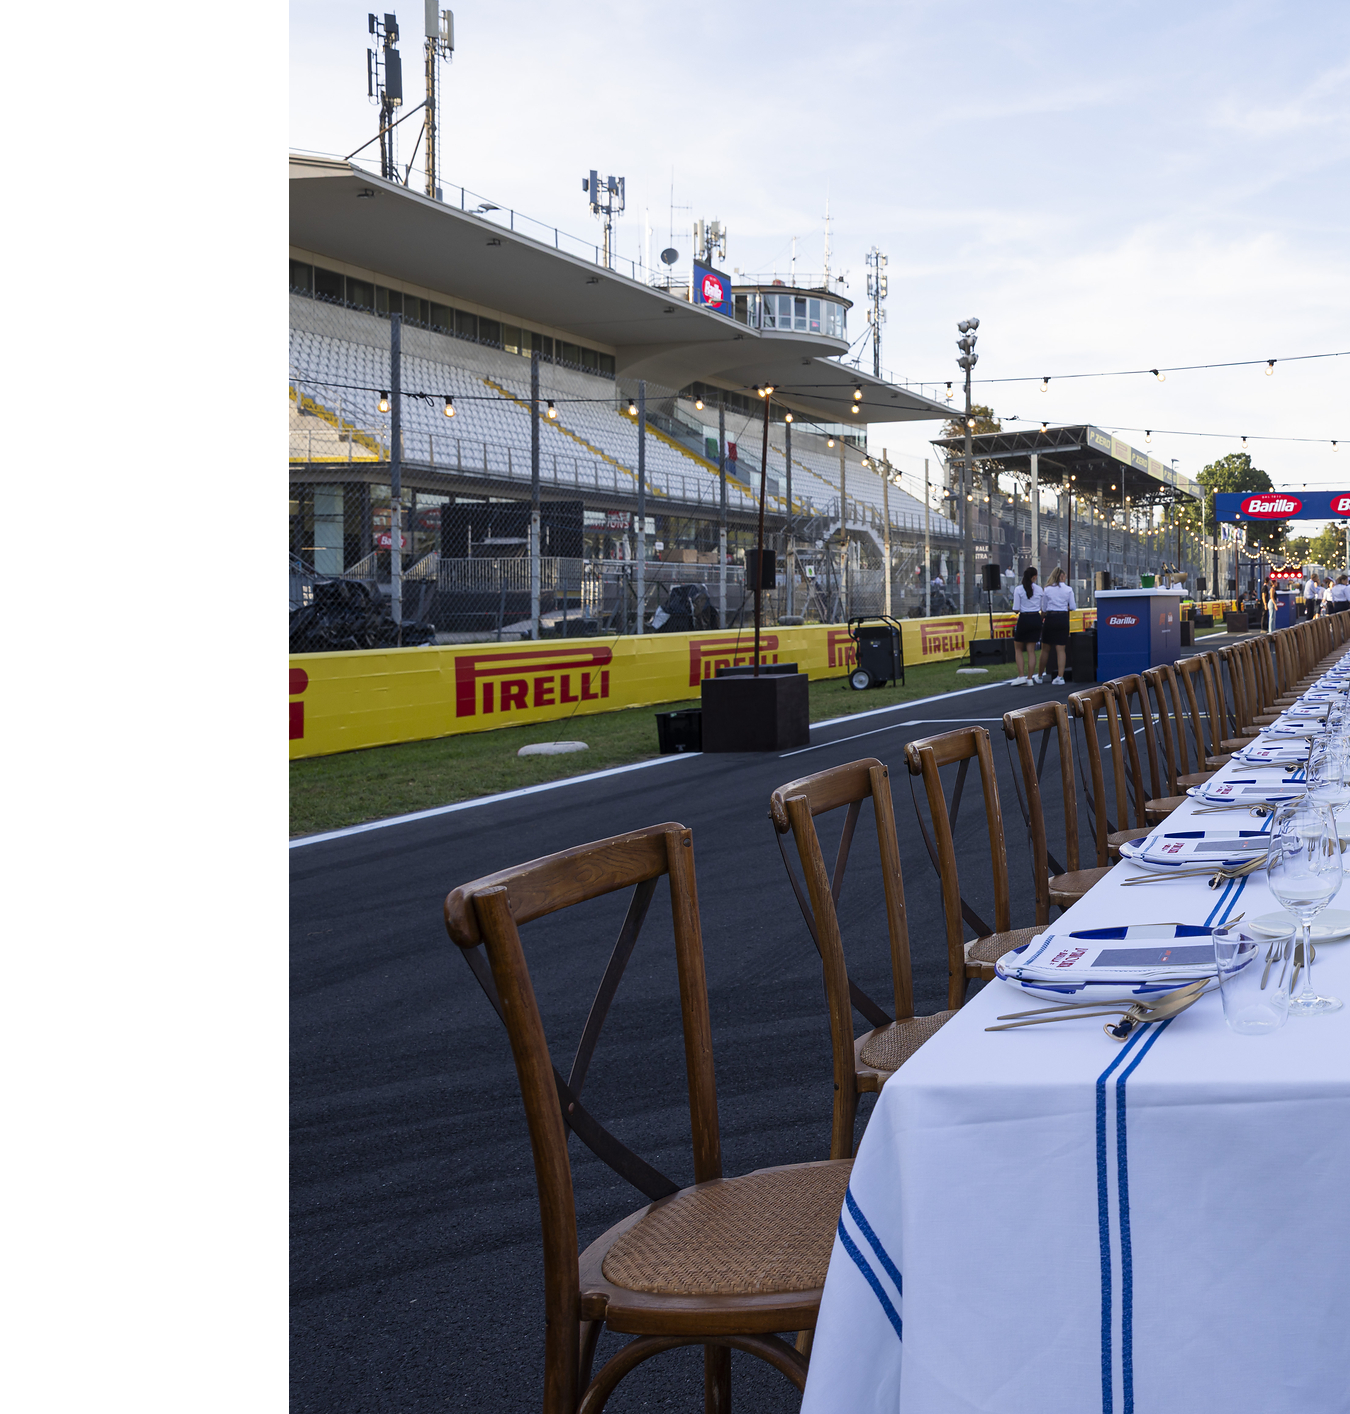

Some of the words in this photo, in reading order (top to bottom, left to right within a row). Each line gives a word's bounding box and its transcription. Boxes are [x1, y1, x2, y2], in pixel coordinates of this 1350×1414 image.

[1248, 499, 1294, 513] Barilla
[1109, 616, 1137, 625] Barilla
[920, 621, 965, 656] PIRELLI
[454, 646, 613, 718] PIRELLI
